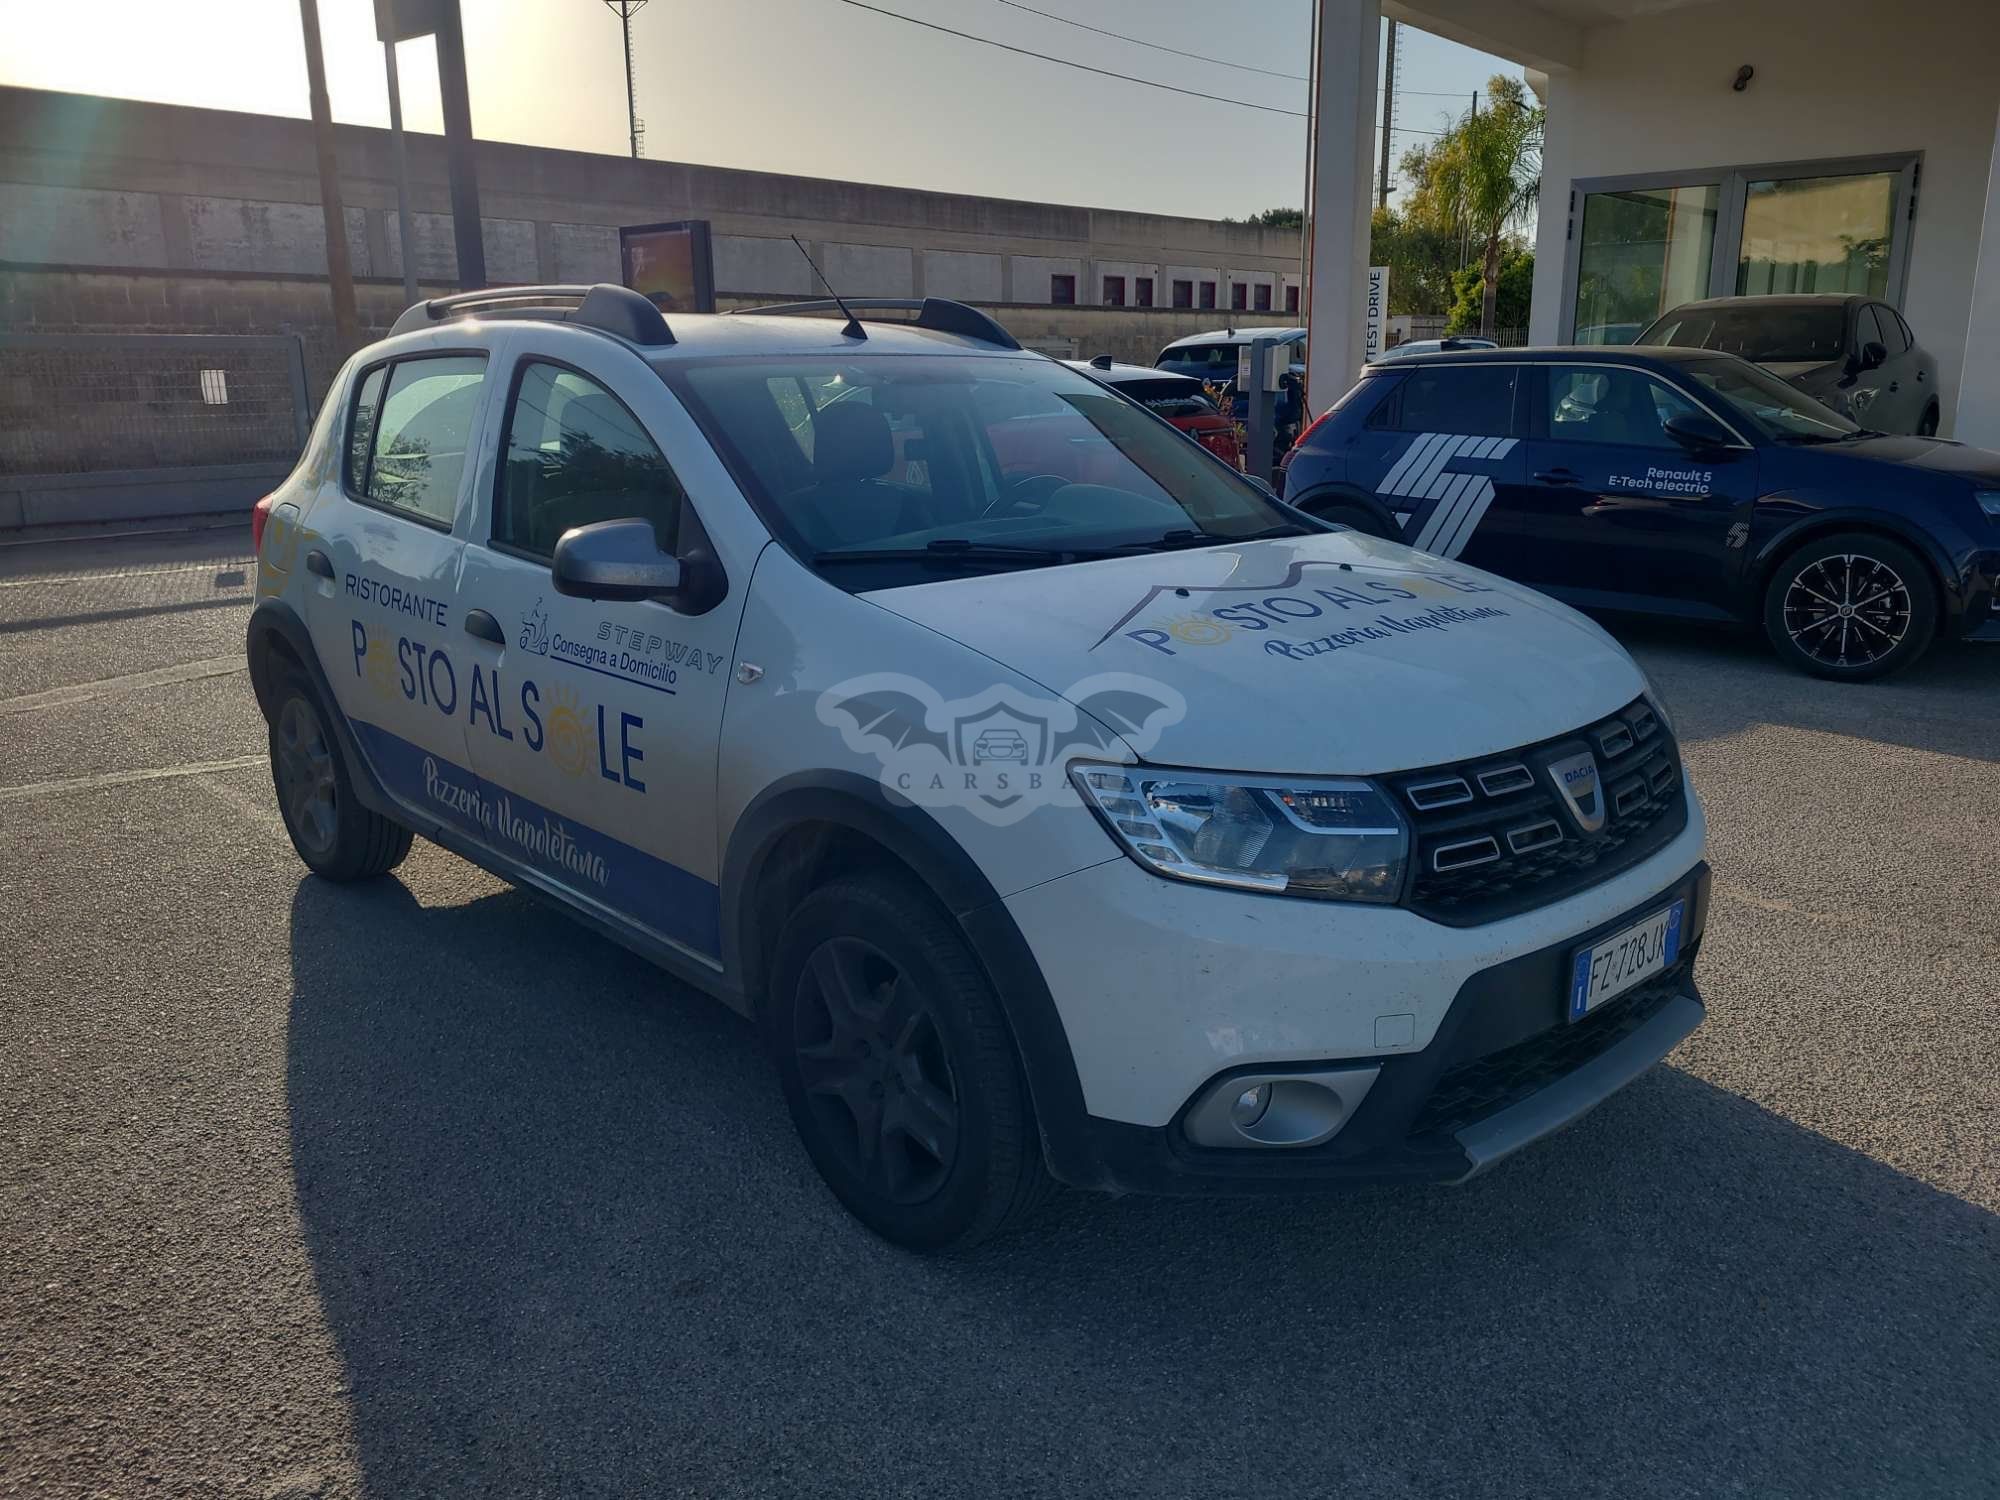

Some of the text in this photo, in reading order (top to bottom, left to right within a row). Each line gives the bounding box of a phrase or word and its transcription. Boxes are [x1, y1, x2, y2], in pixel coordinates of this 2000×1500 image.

[1366, 271, 1381, 359] TEST DRIVE
[1608, 475, 1709, 494] E-Tech electric
[1647, 467, 1712, 482] Renault 5
[345, 574, 448, 627] RISTORANTE
[1316, 585, 1391, 610] AL
[552, 633, 677, 685] Consegna a Domicilio
[597, 621, 723, 675] STEPWAY
[1264, 627, 1392, 661] Pizzeria
[470, 664, 513, 742] AL
[423, 756, 495, 830] Pizzeria
[1564, 765, 1595, 784] DACIA
